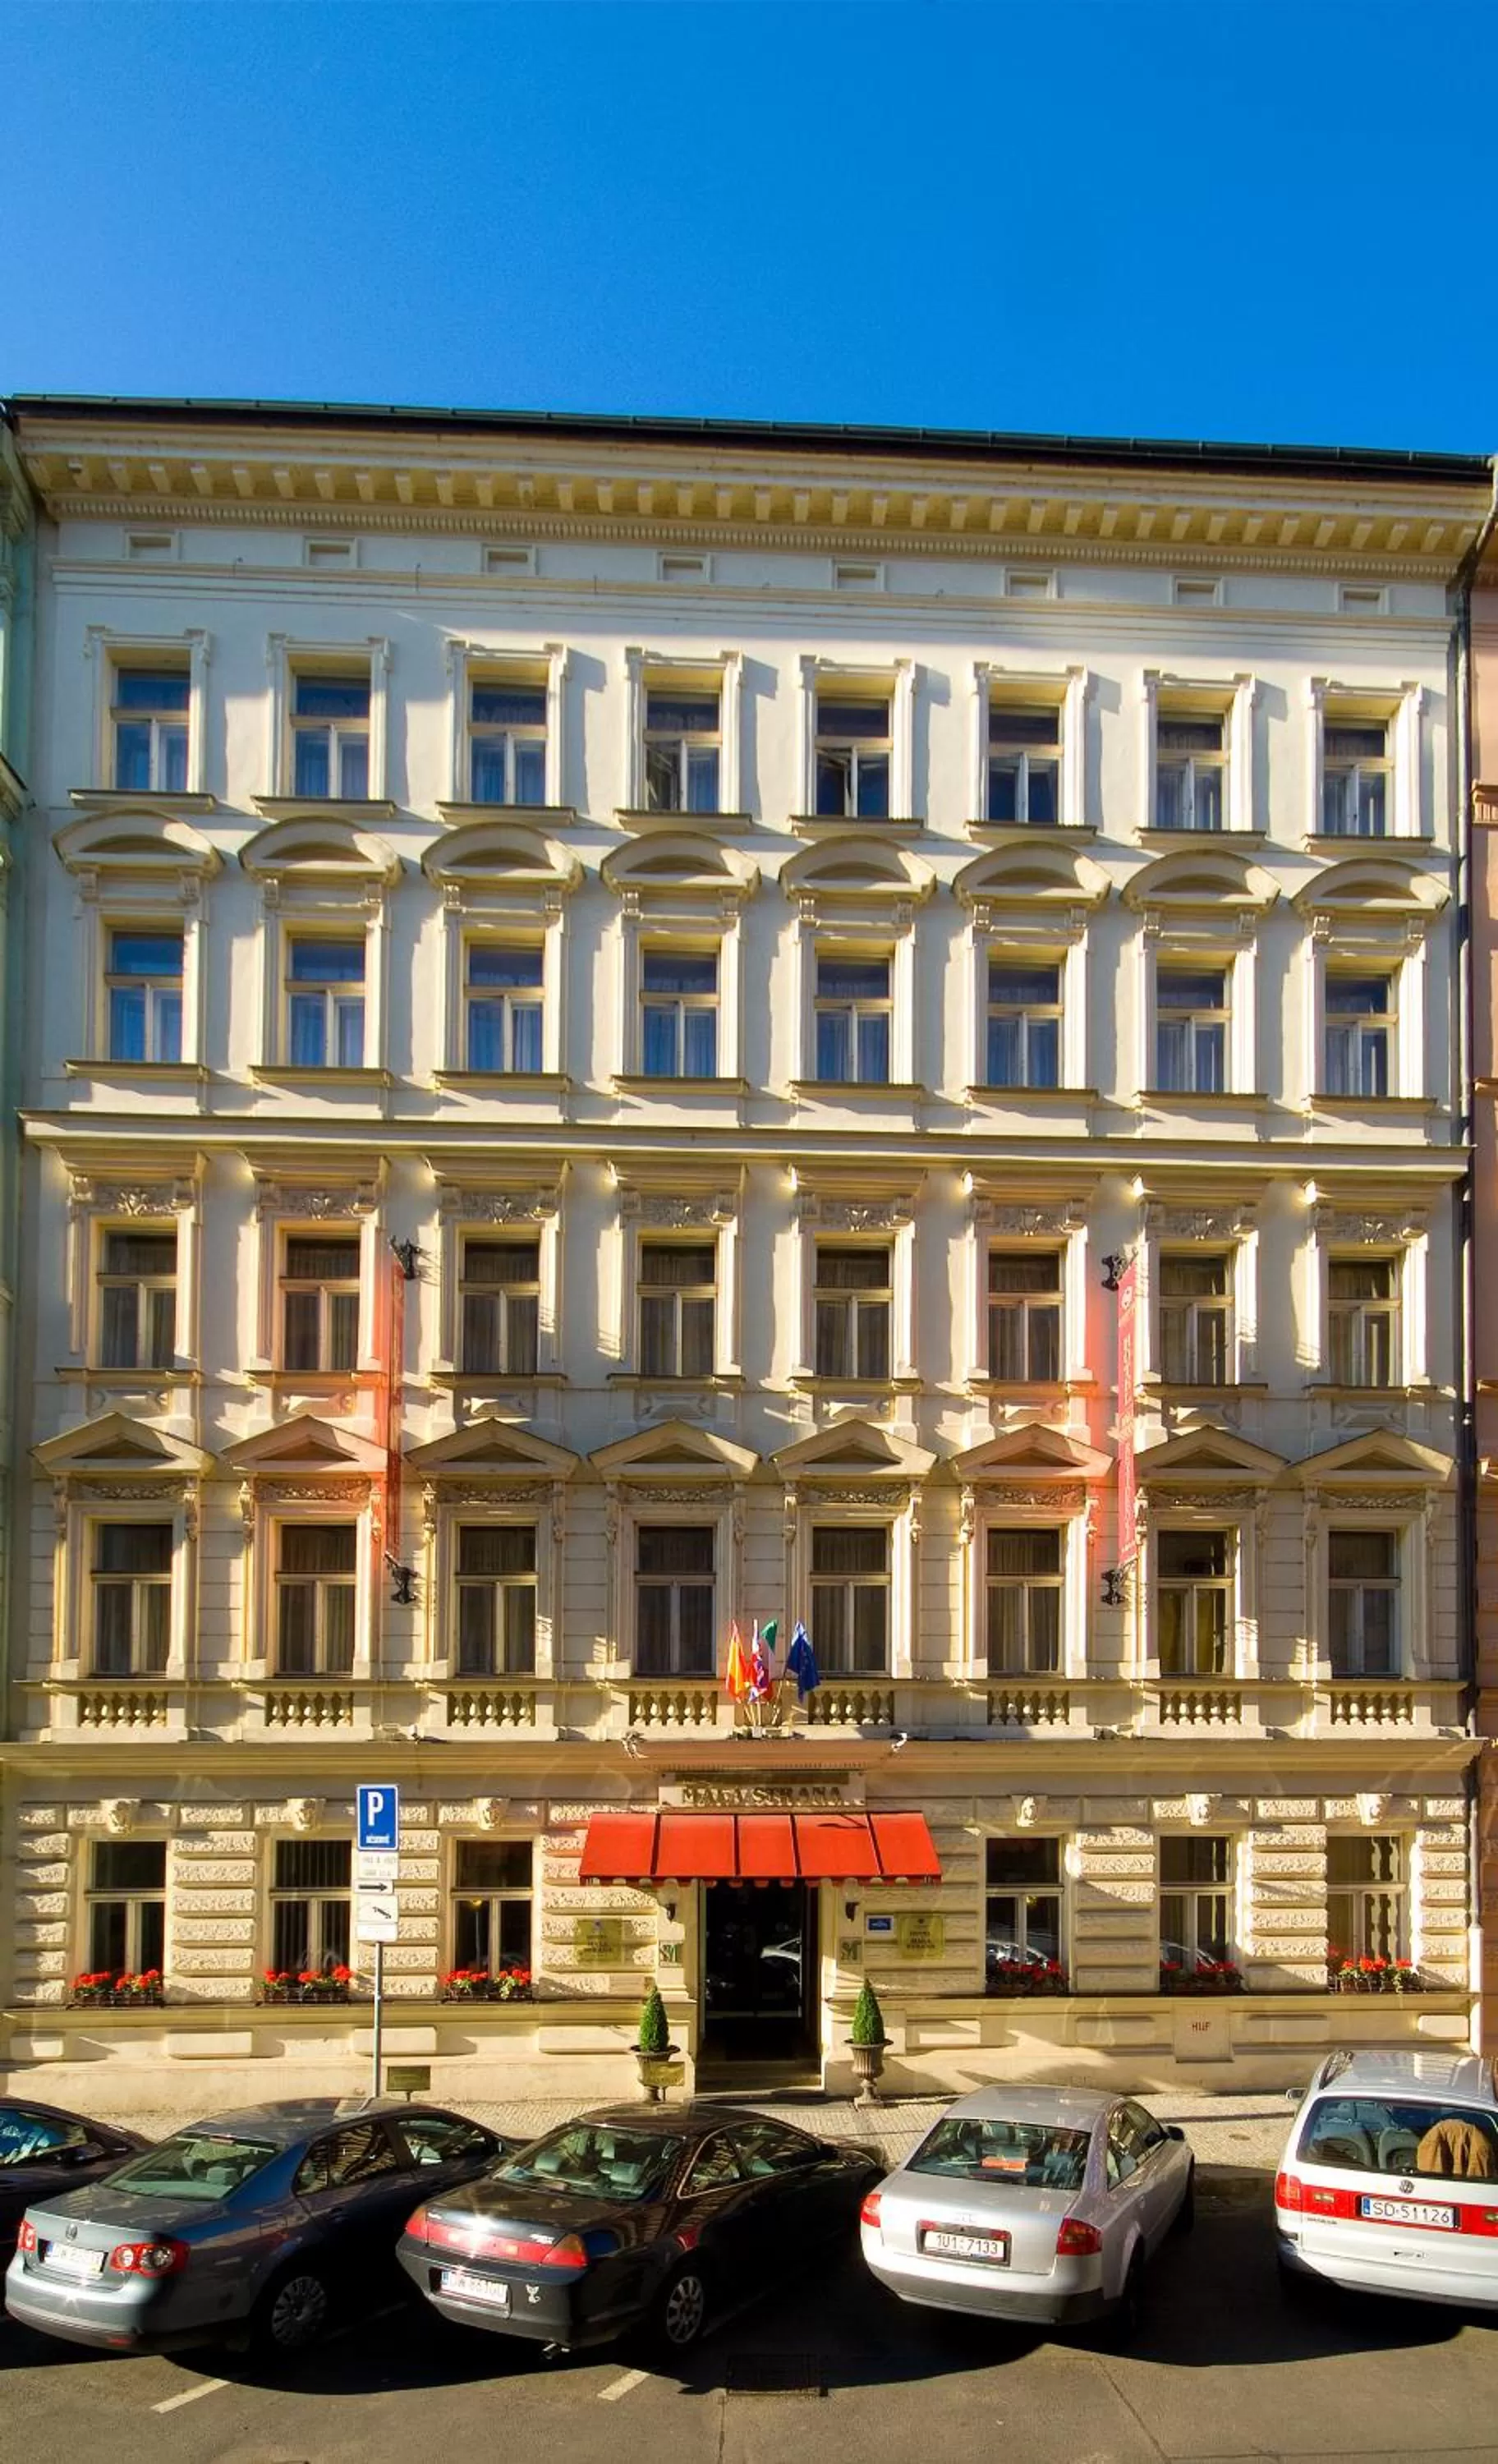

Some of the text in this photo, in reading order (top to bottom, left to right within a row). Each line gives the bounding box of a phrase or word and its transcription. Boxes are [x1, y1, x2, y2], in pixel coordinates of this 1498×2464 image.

[367, 1791, 384, 1826] P
[1372, 2202, 1450, 2223] SD 51126
[967, 2239, 998, 2255] 7133
